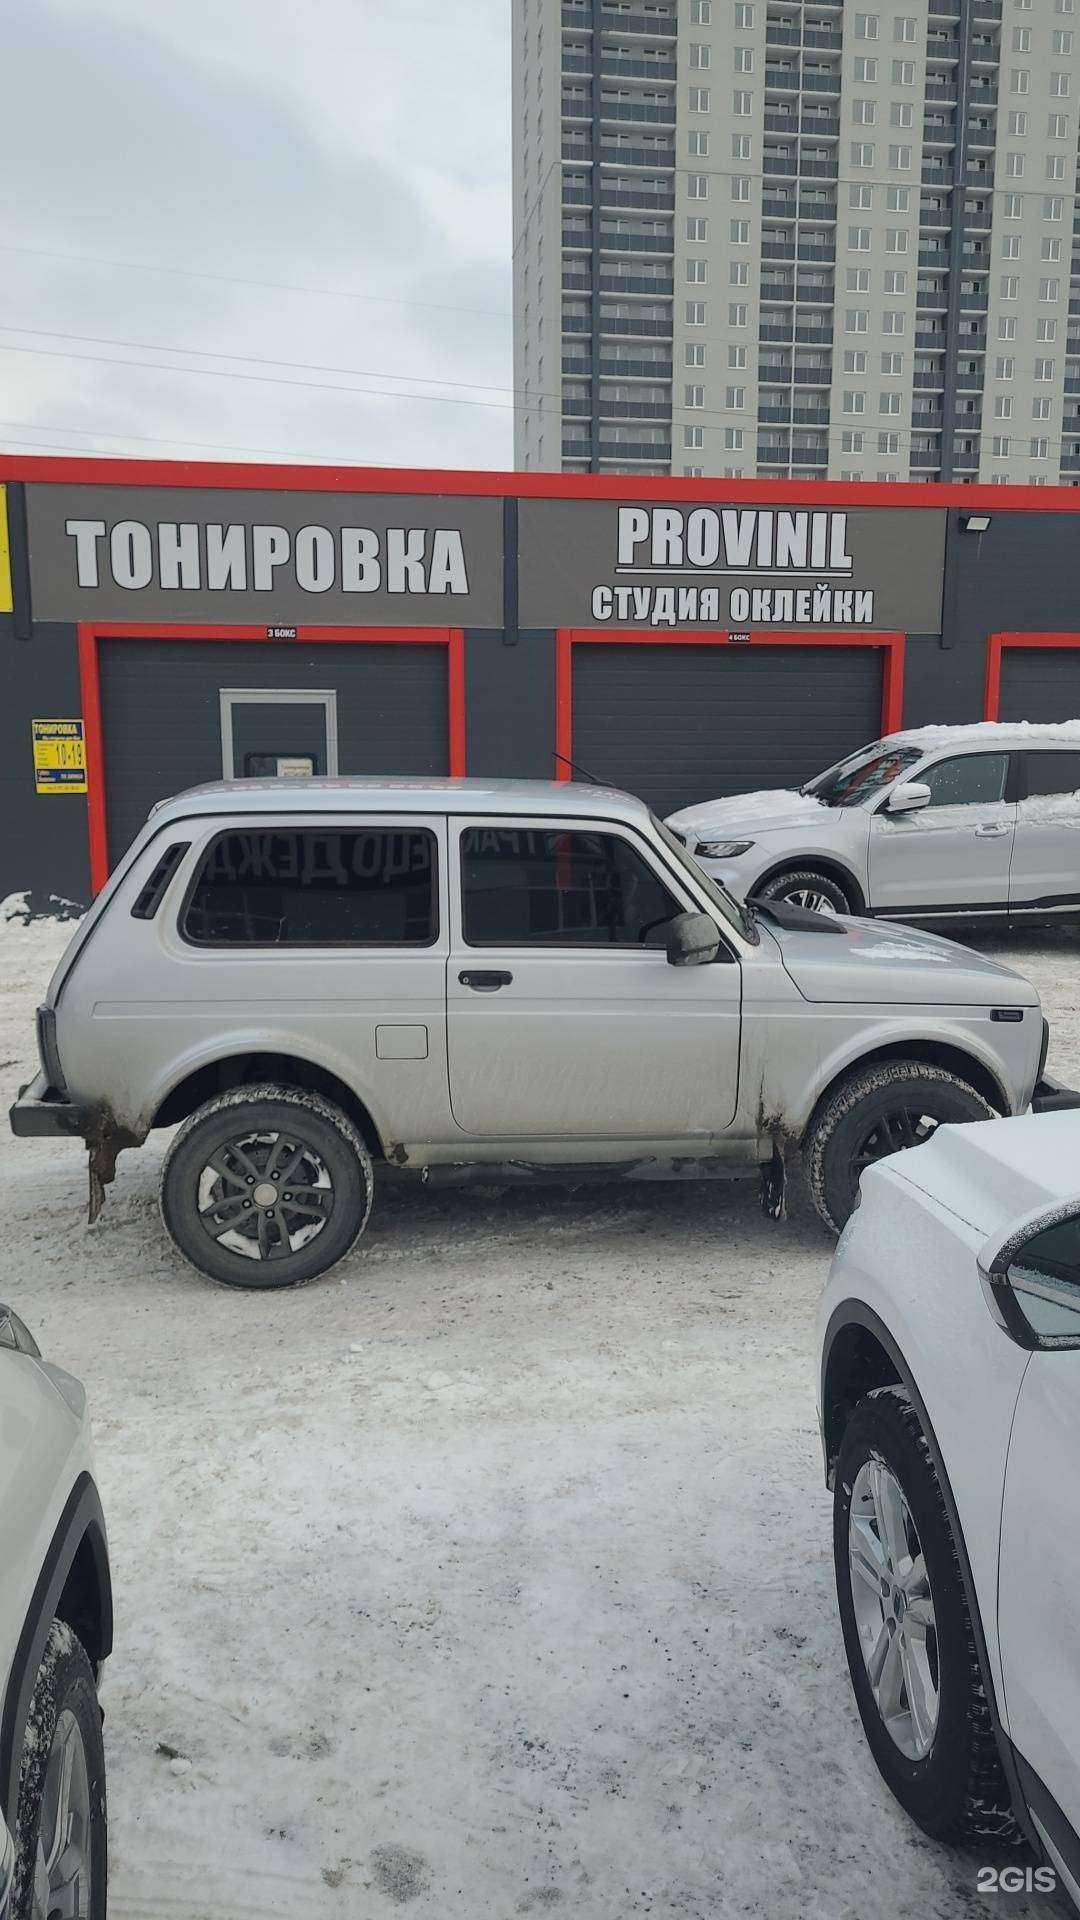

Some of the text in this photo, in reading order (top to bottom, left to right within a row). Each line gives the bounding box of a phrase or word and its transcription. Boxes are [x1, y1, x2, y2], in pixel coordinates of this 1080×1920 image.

[65, 519, 469, 595] ТОНИРОВКА
[617, 507, 853, 569] PROVINIL
[592, 583, 874, 626] СТУДИЯ ОКЛЕЙКИ
[274, 628, 296, 638] БОКС
